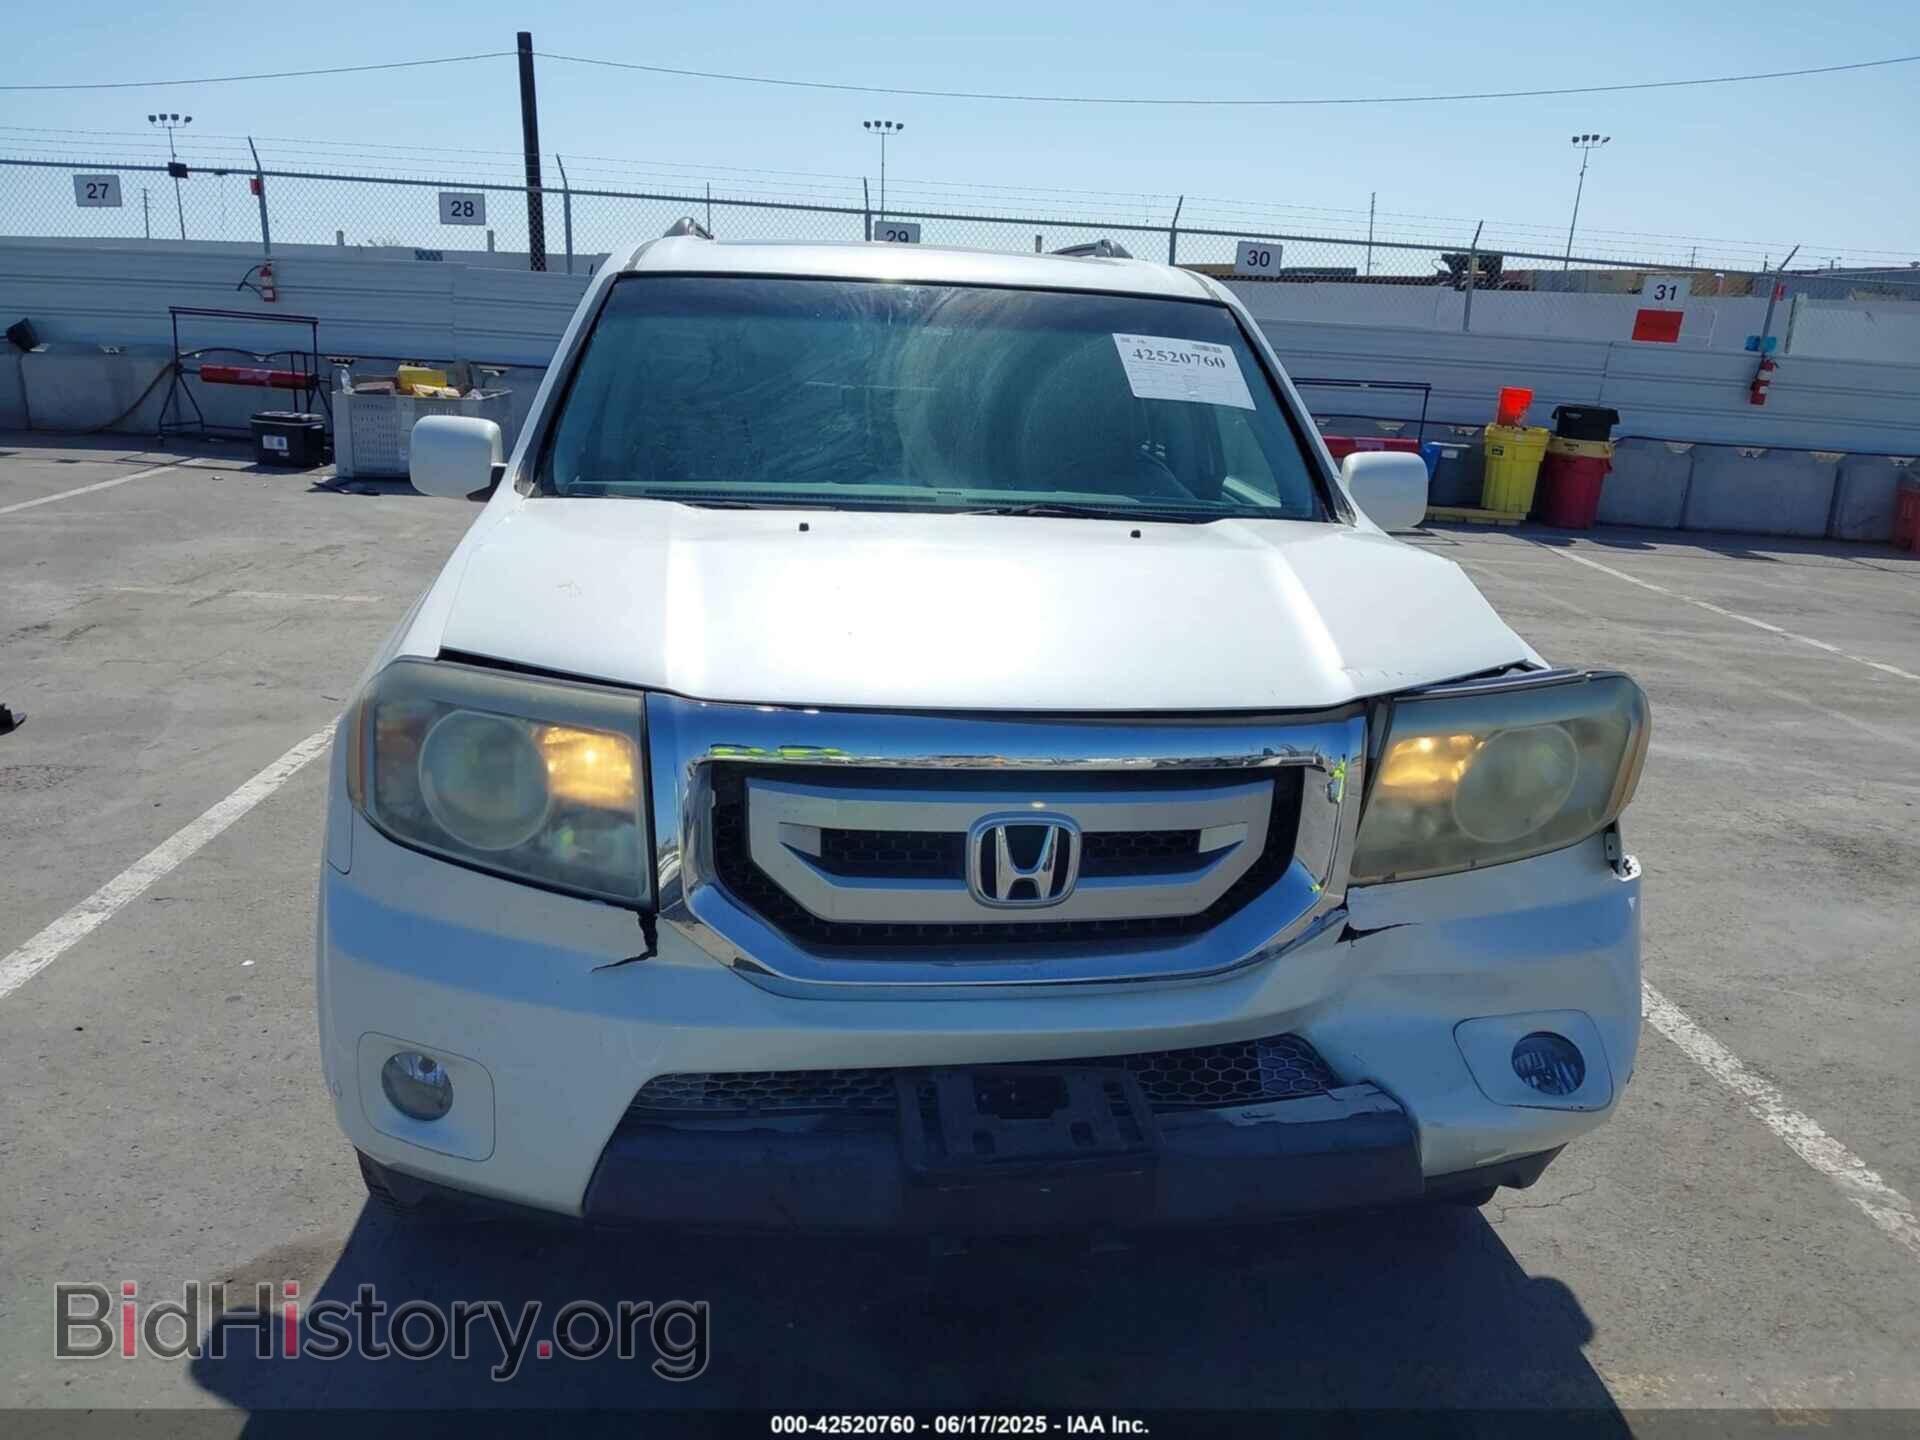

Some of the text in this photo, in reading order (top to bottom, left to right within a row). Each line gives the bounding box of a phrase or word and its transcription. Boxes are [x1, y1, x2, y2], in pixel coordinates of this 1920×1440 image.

[86, 183, 109, 199] 27
[451, 200, 474, 217] 28
[886, 230, 909, 243] 29
[1247, 250, 1270, 267] 30
[1655, 284, 1677, 301] 31
[1132, 348, 1226, 369] 42520760
